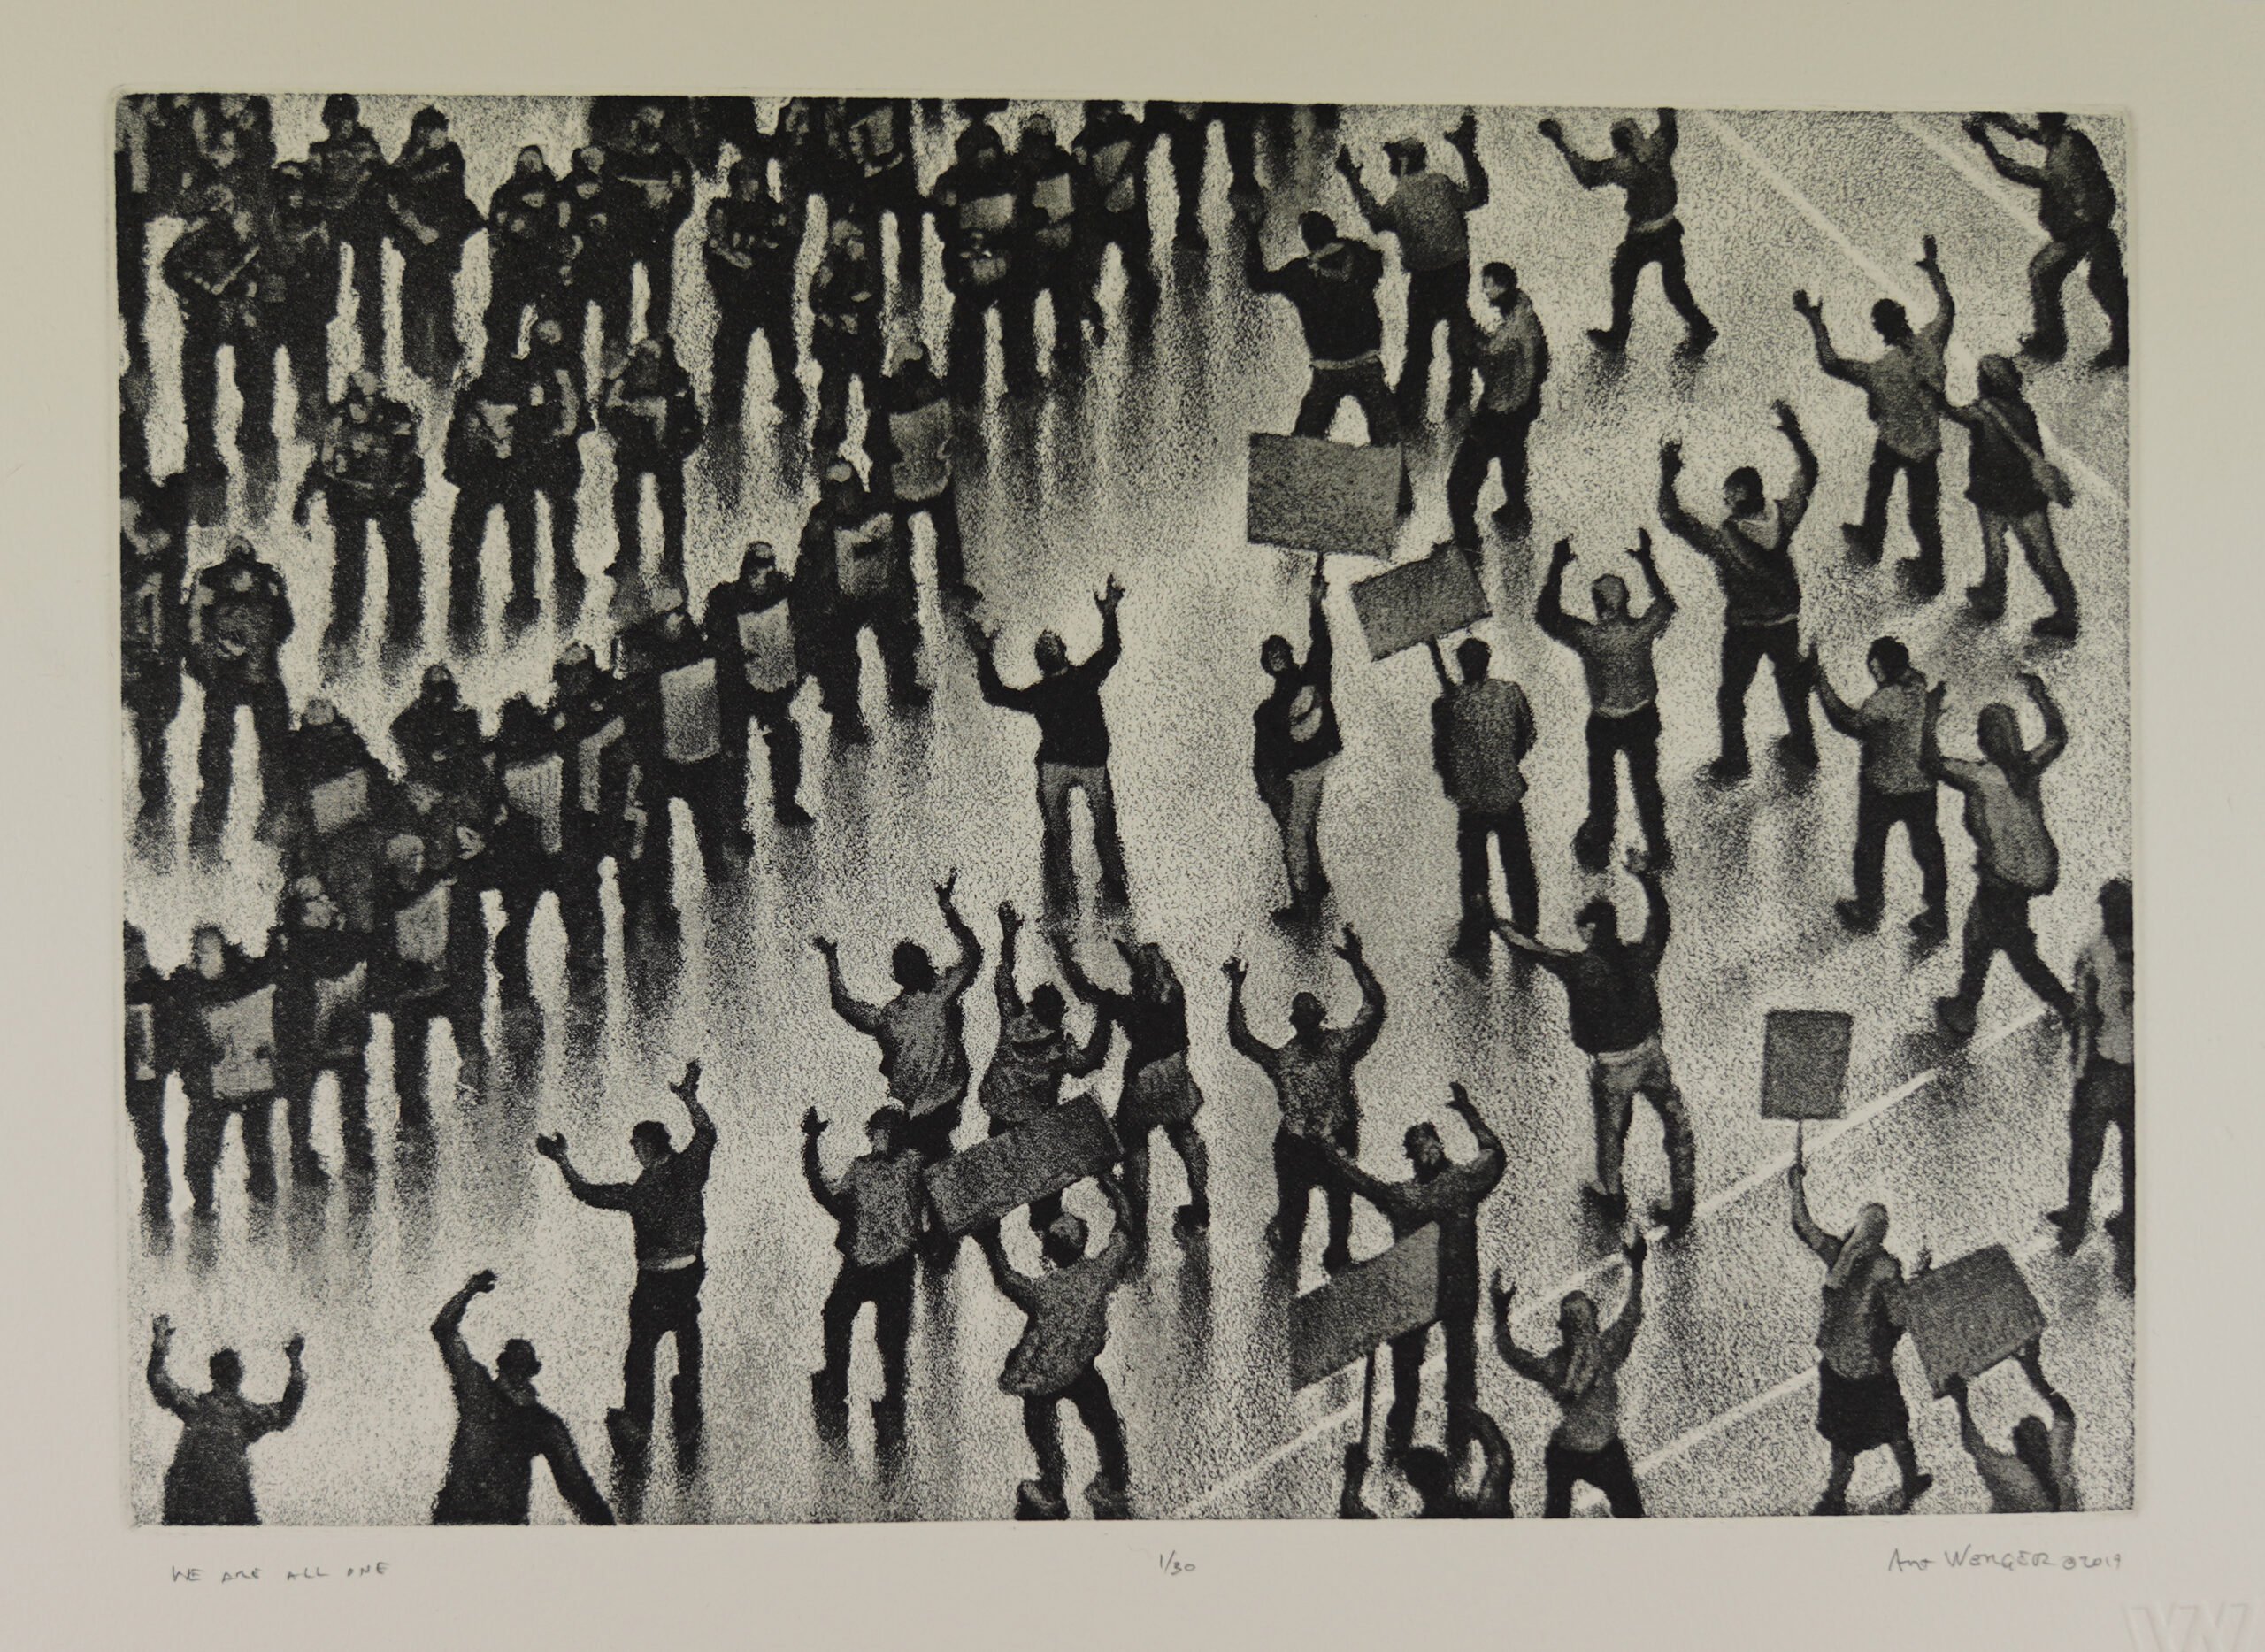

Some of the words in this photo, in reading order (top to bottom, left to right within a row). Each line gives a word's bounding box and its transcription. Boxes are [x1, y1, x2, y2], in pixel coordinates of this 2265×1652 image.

[172, 1565, 204, 1582] WE
[286, 1566, 330, 1581] ALL
[346, 1561, 391, 1577] ONE
[1159, 1549, 1196, 1576] 1/30
